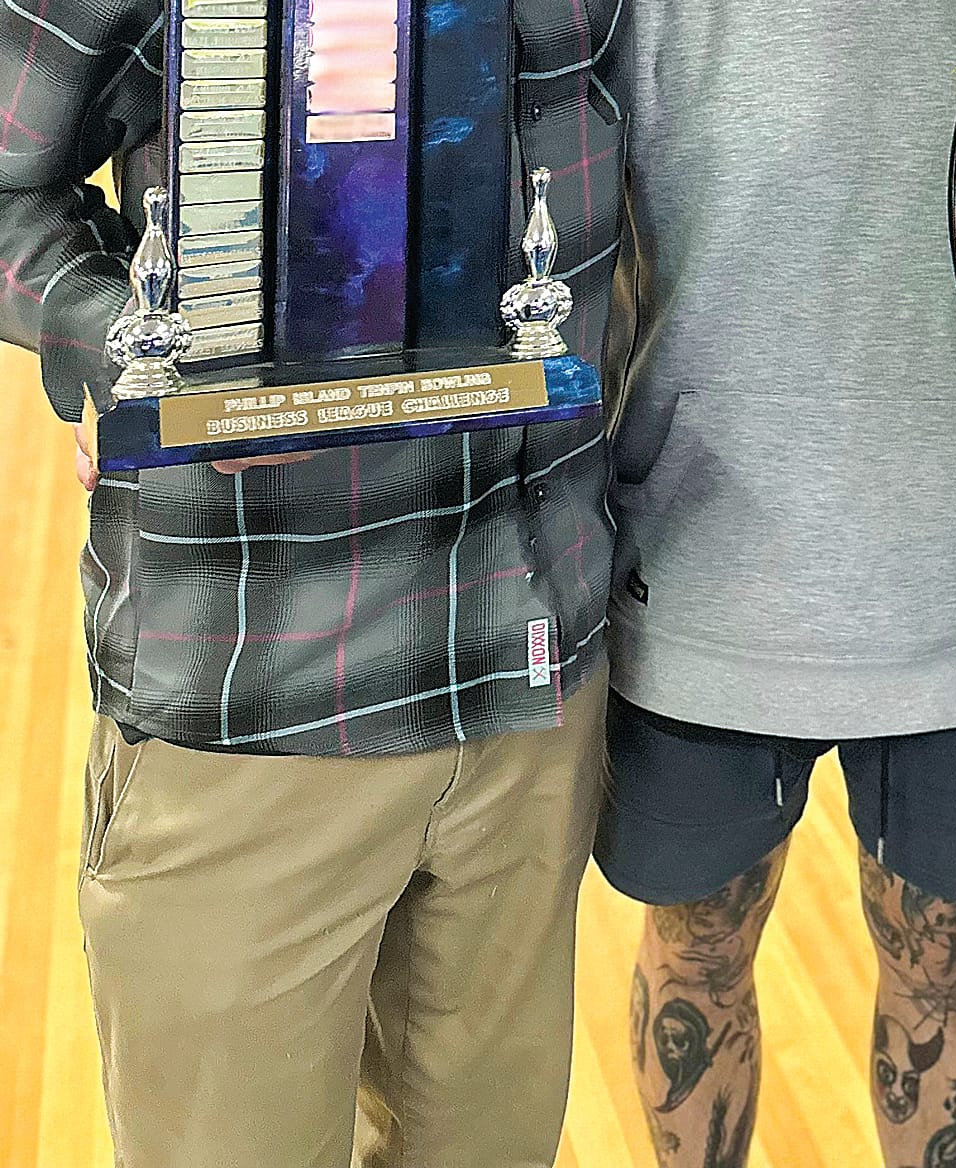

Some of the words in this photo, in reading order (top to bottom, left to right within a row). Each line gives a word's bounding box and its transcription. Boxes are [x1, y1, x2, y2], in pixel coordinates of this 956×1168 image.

[224, 394, 285, 412] PHILLIP
[292, 387, 351, 405] ISLAND
[357, 381, 415, 398] TENPIN
[206, 410, 308, 435] BUSINESS
[531, 623, 546, 665] DIXXON
